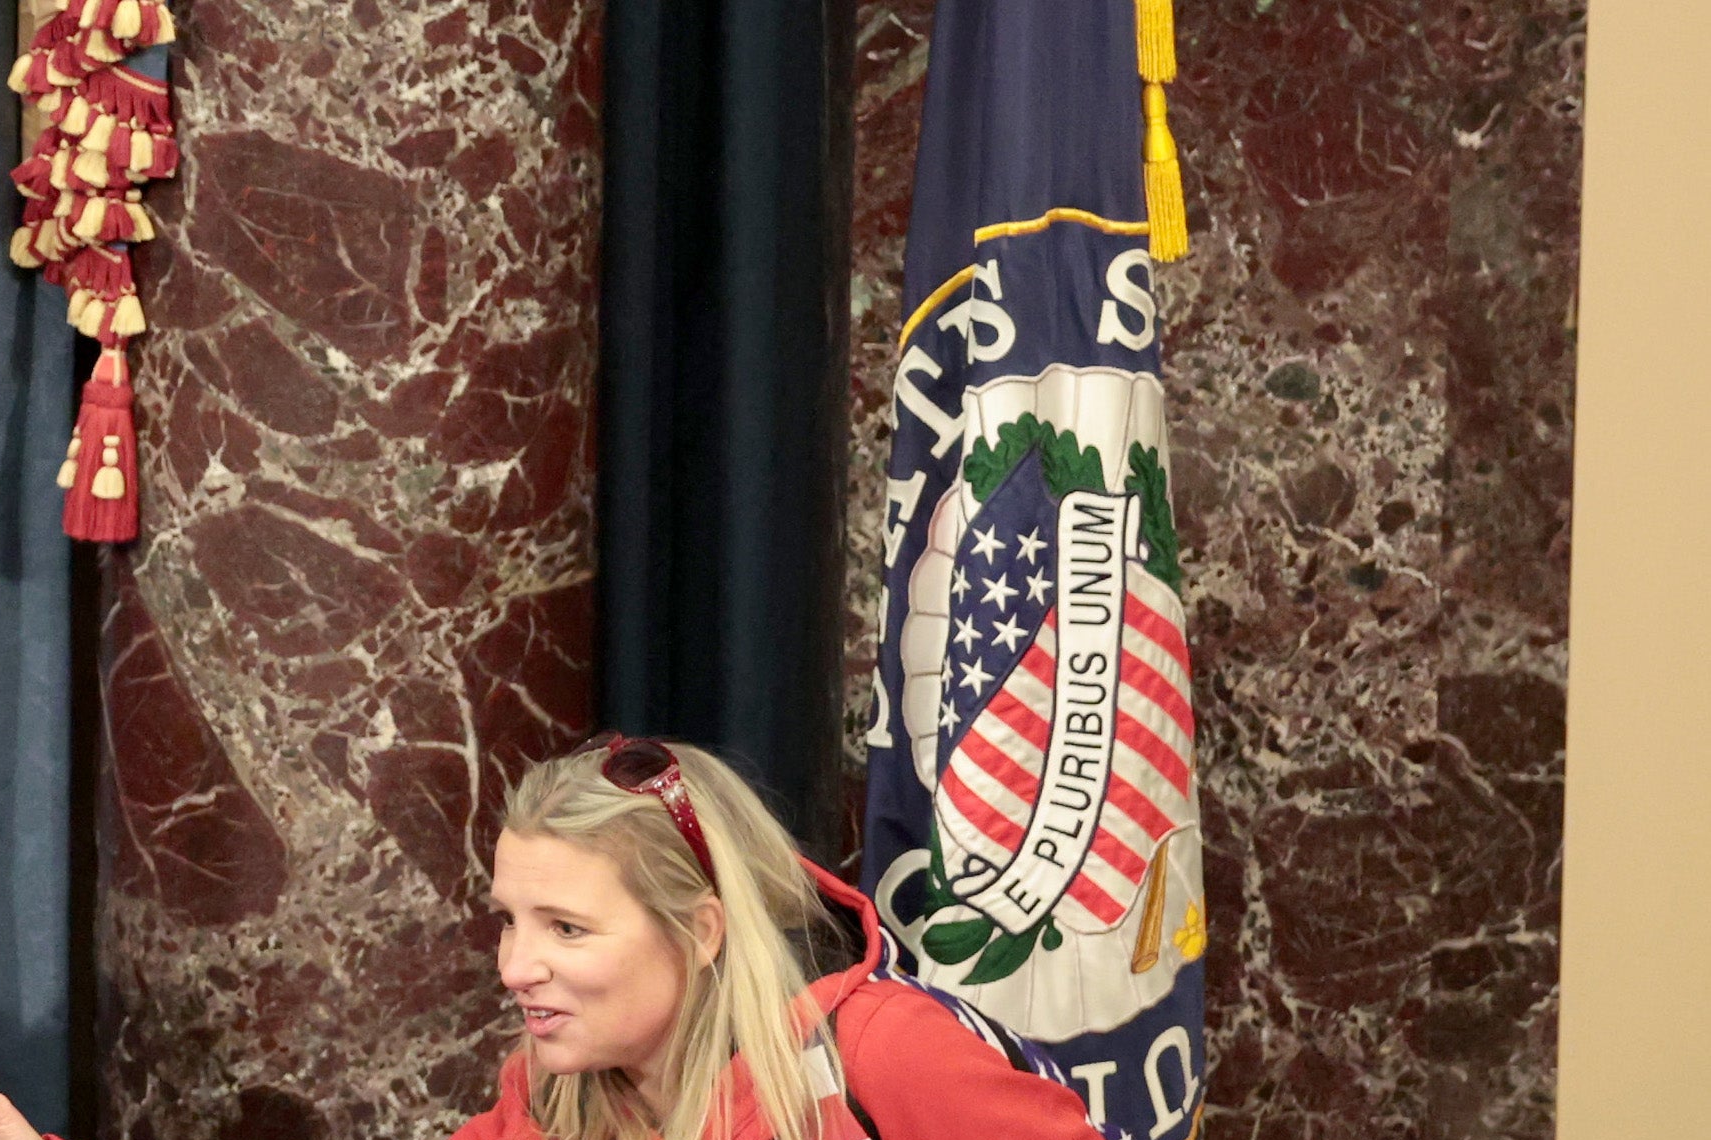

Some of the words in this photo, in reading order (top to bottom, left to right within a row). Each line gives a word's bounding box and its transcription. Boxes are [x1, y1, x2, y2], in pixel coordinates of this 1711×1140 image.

[1069, 502, 1115, 627] UNUM
[1033, 652, 1108, 868] PLURIBUS
[1005, 880, 1042, 916] E
